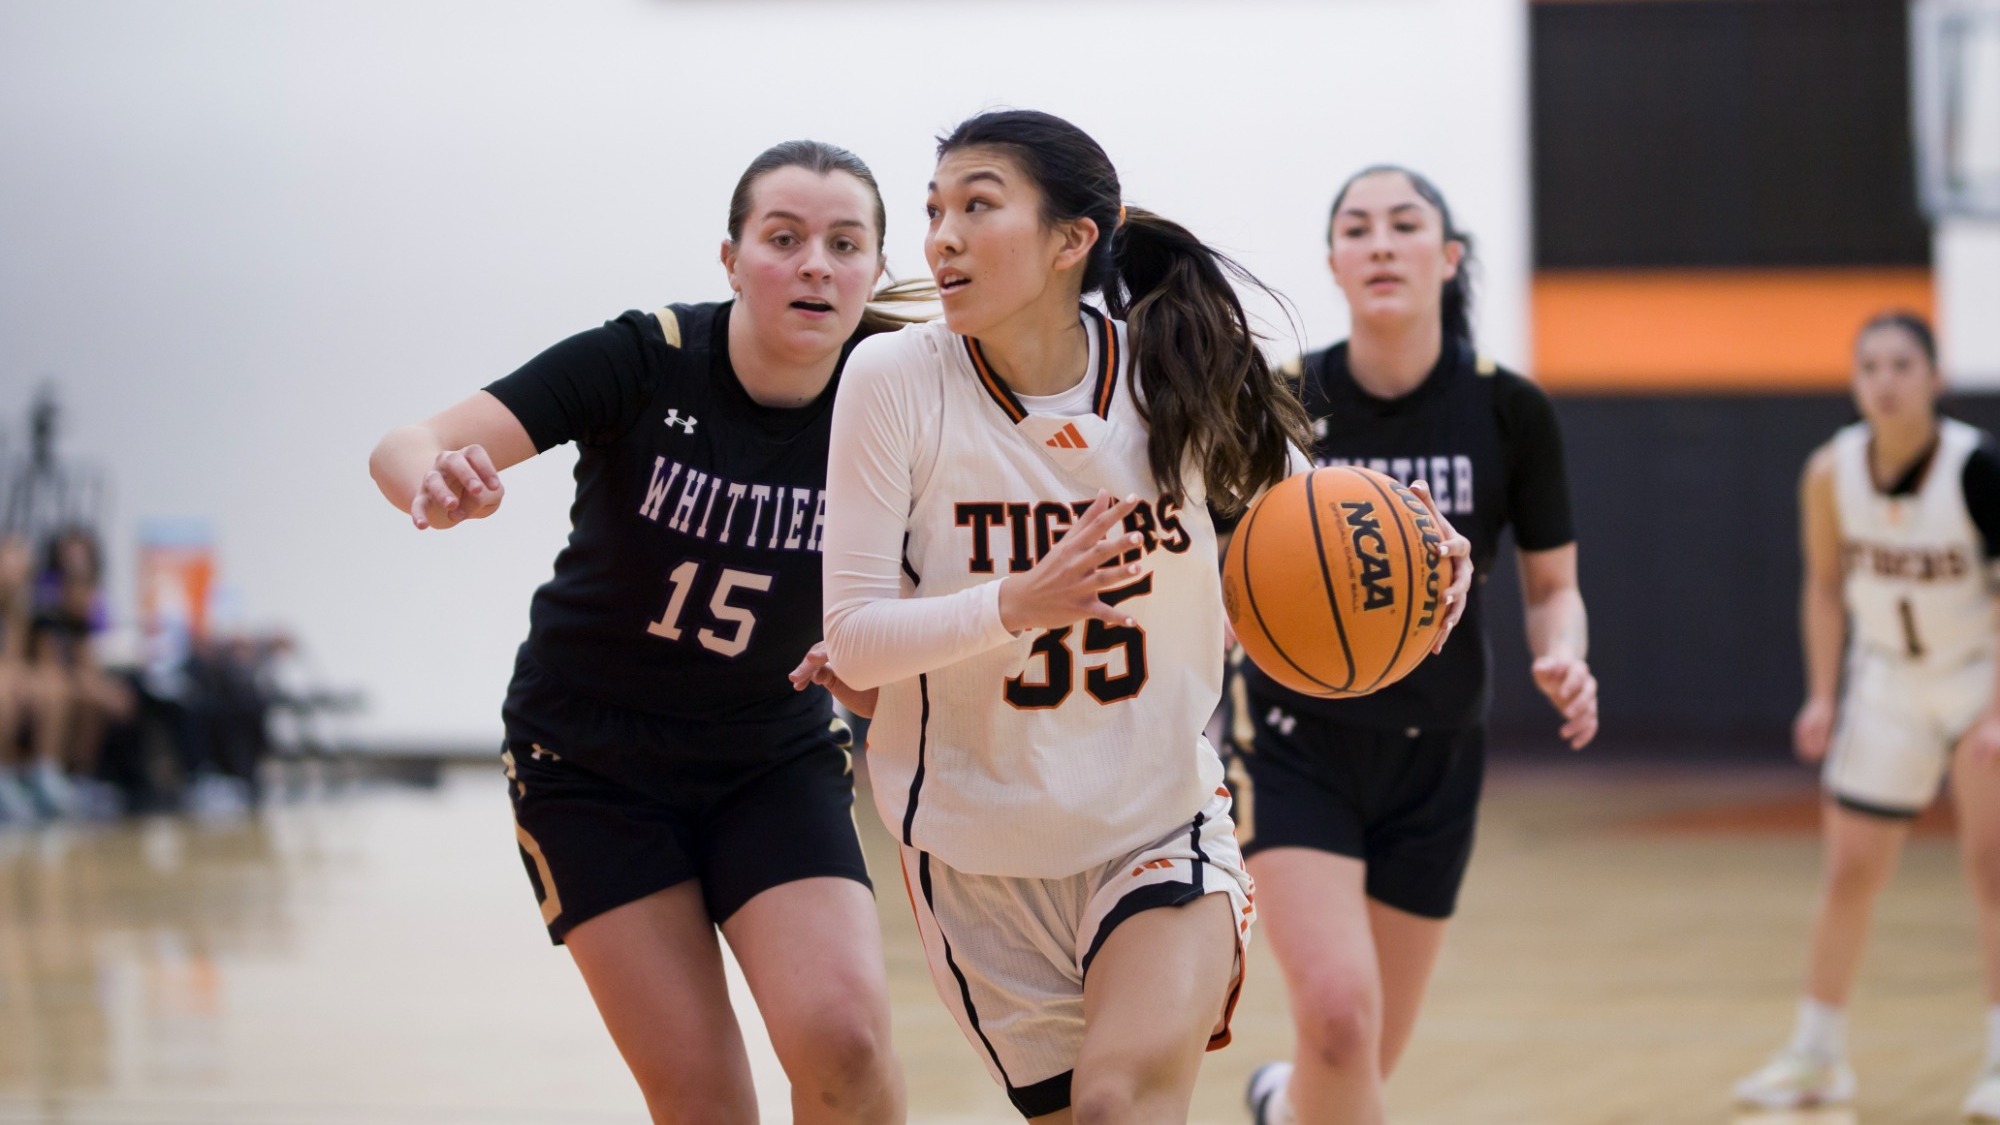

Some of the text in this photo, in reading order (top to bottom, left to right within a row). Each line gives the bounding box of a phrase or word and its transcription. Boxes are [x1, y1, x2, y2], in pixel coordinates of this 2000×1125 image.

[639, 455, 826, 551] WHITTIER
[1341, 501, 1395, 612] NCAA
[647, 560, 773, 658] 15
